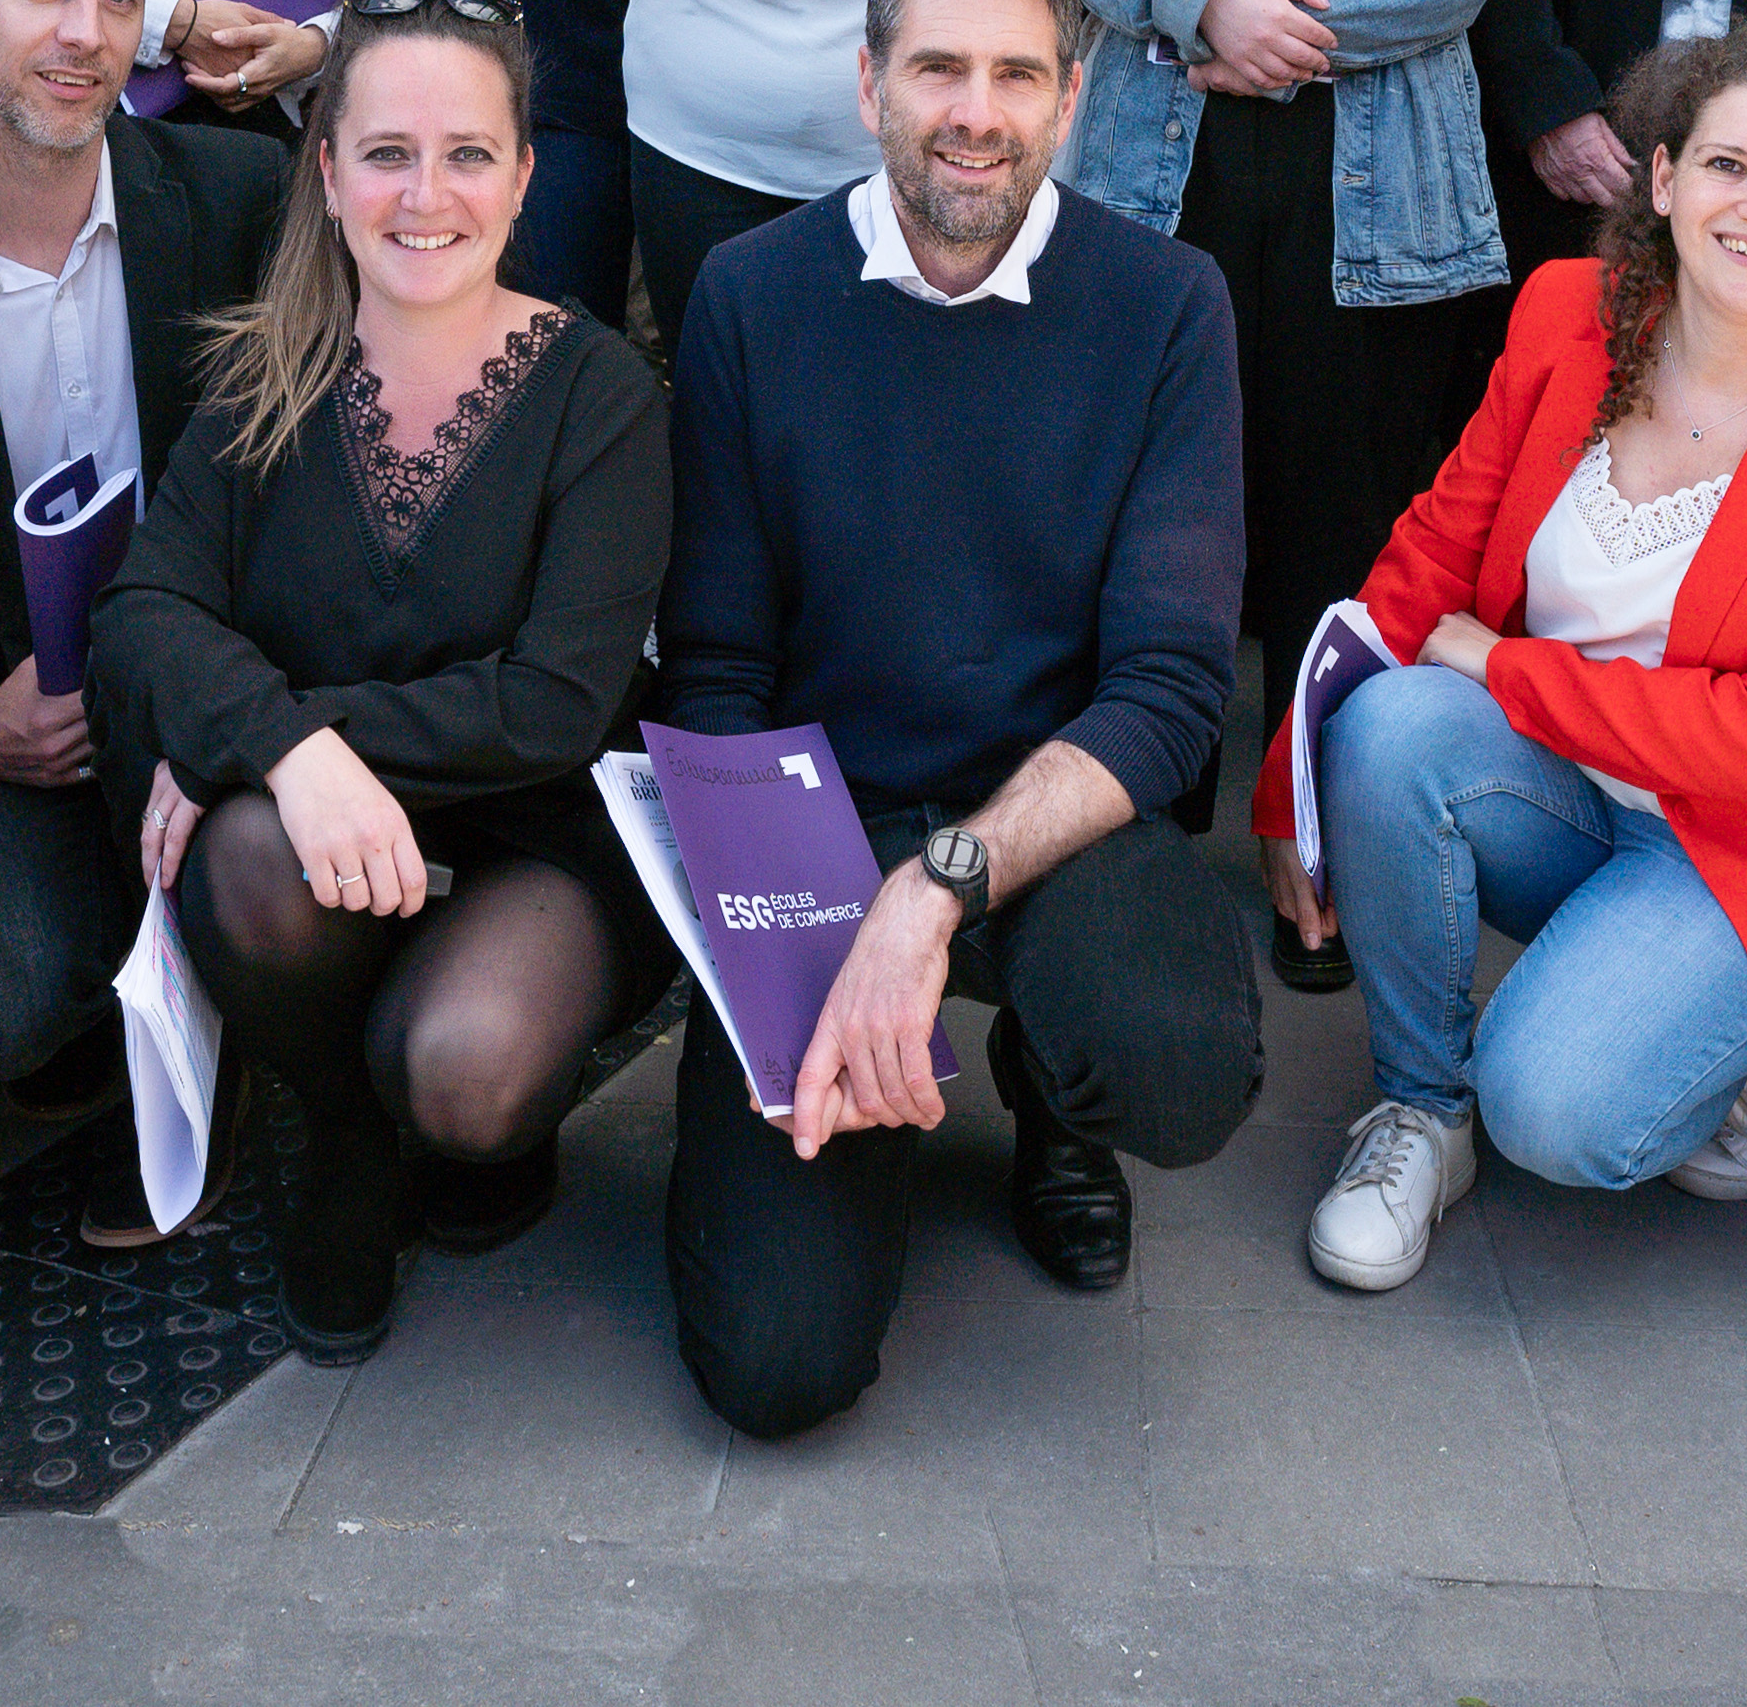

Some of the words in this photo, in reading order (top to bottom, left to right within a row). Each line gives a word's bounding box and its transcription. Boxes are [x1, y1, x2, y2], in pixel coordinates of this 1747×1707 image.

[717, 892, 776, 930] ESG
[770, 891, 817, 911] ÉCOLES
[777, 913, 796, 929] DE
[796, 901, 864, 929] COMMERCE
